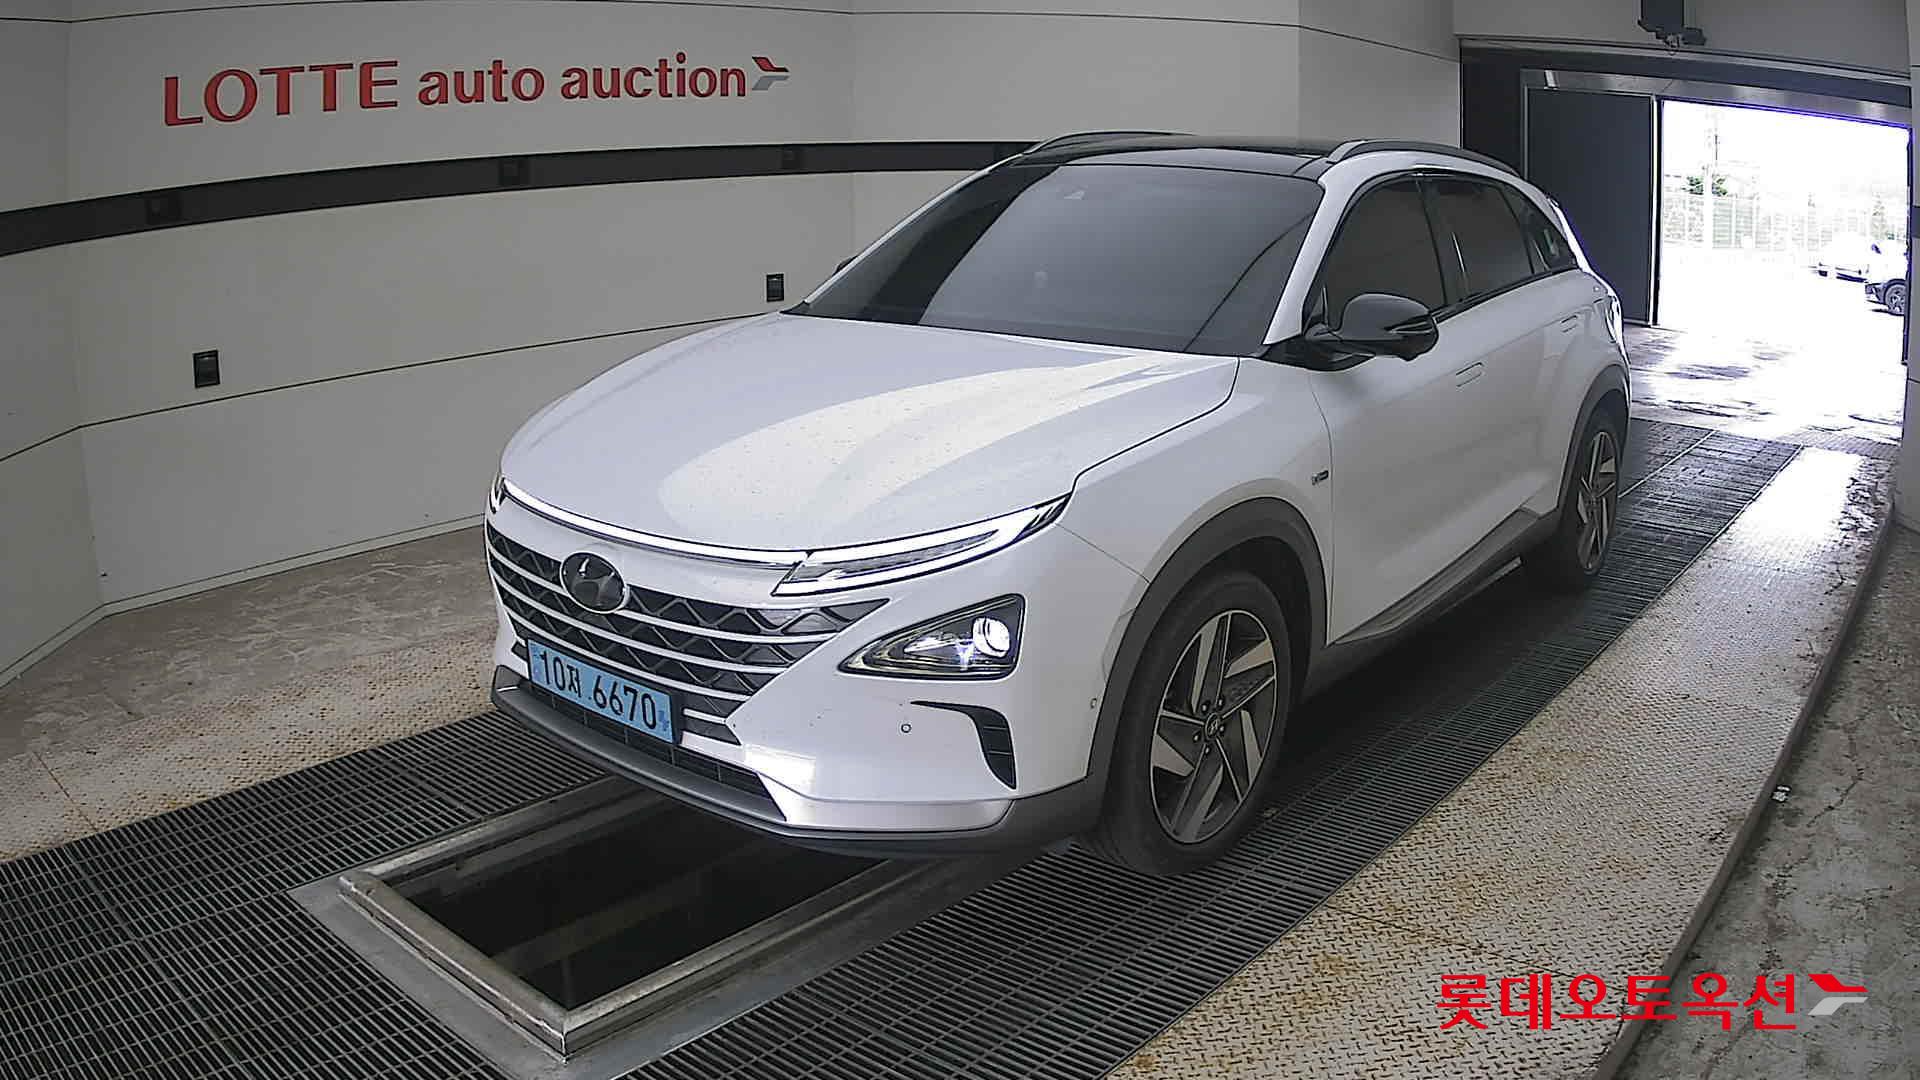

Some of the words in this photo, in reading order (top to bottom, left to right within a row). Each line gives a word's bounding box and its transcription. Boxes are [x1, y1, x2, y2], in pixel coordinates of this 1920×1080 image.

[164, 60, 399, 127] LOTTE
[417, 59, 546, 106] auto
[560, 52, 748, 99] auction
[593, 675, 657, 730] 6670
